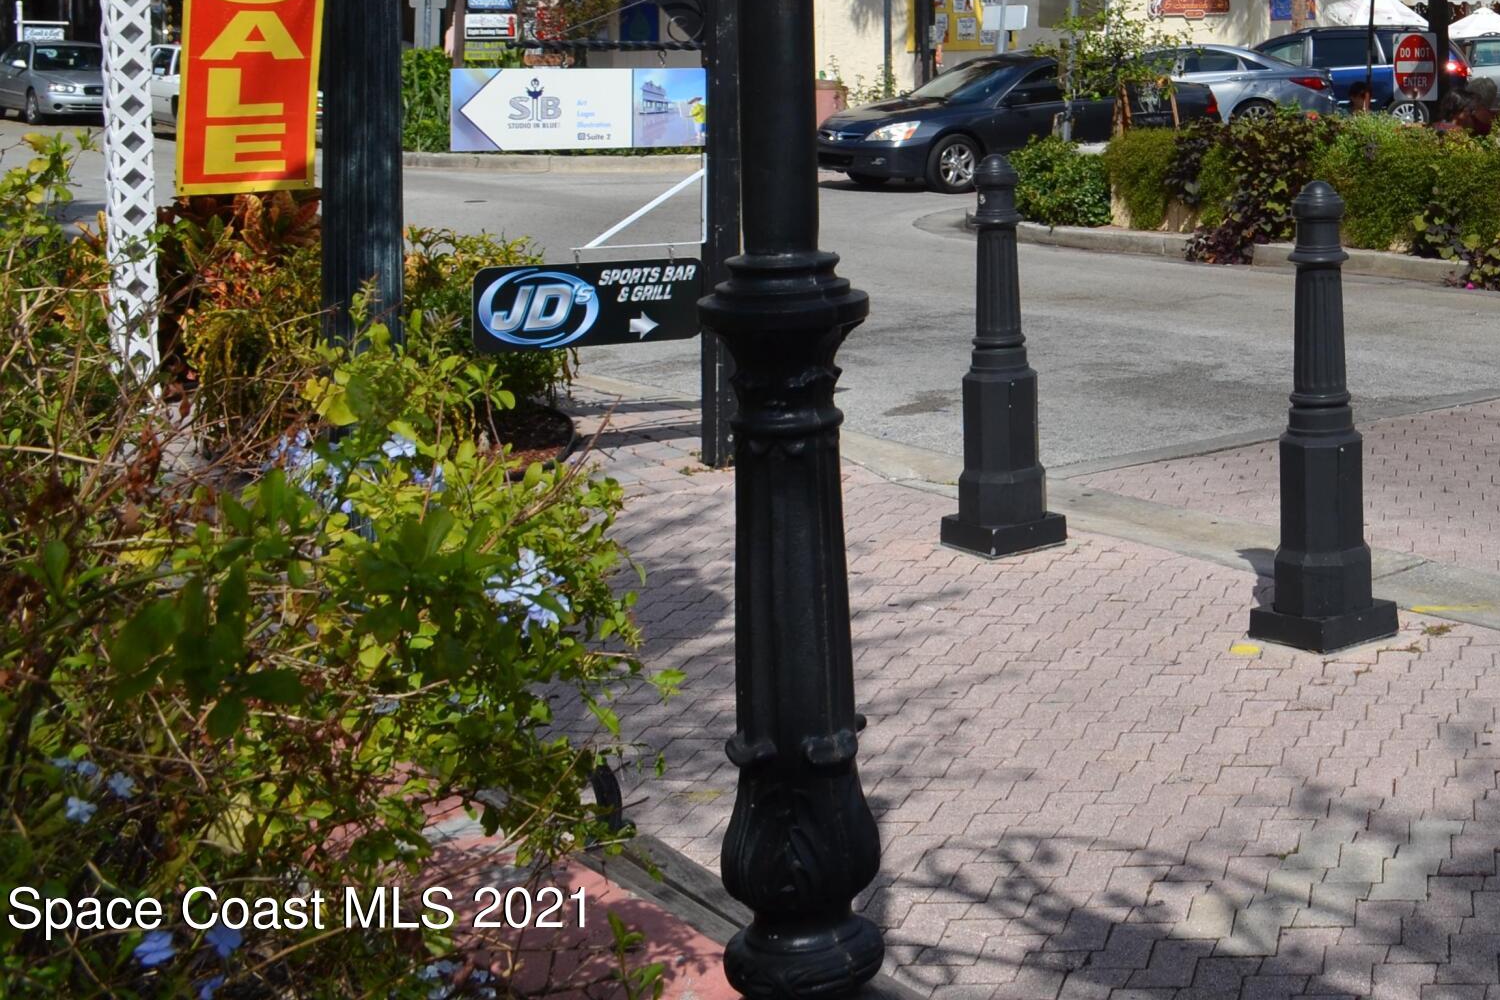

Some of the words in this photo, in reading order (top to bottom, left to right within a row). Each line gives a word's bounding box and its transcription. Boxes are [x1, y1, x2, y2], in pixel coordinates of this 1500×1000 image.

[1399, 47, 1412, 58] DO
[1414, 47, 1431, 58] NOT
[1402, 76, 1427, 87] ENTER
[598, 266, 661, 286] SPORTS
[661, 264, 697, 282] BAR
[616, 286, 630, 303] &
[630, 283, 672, 302] GRILL
